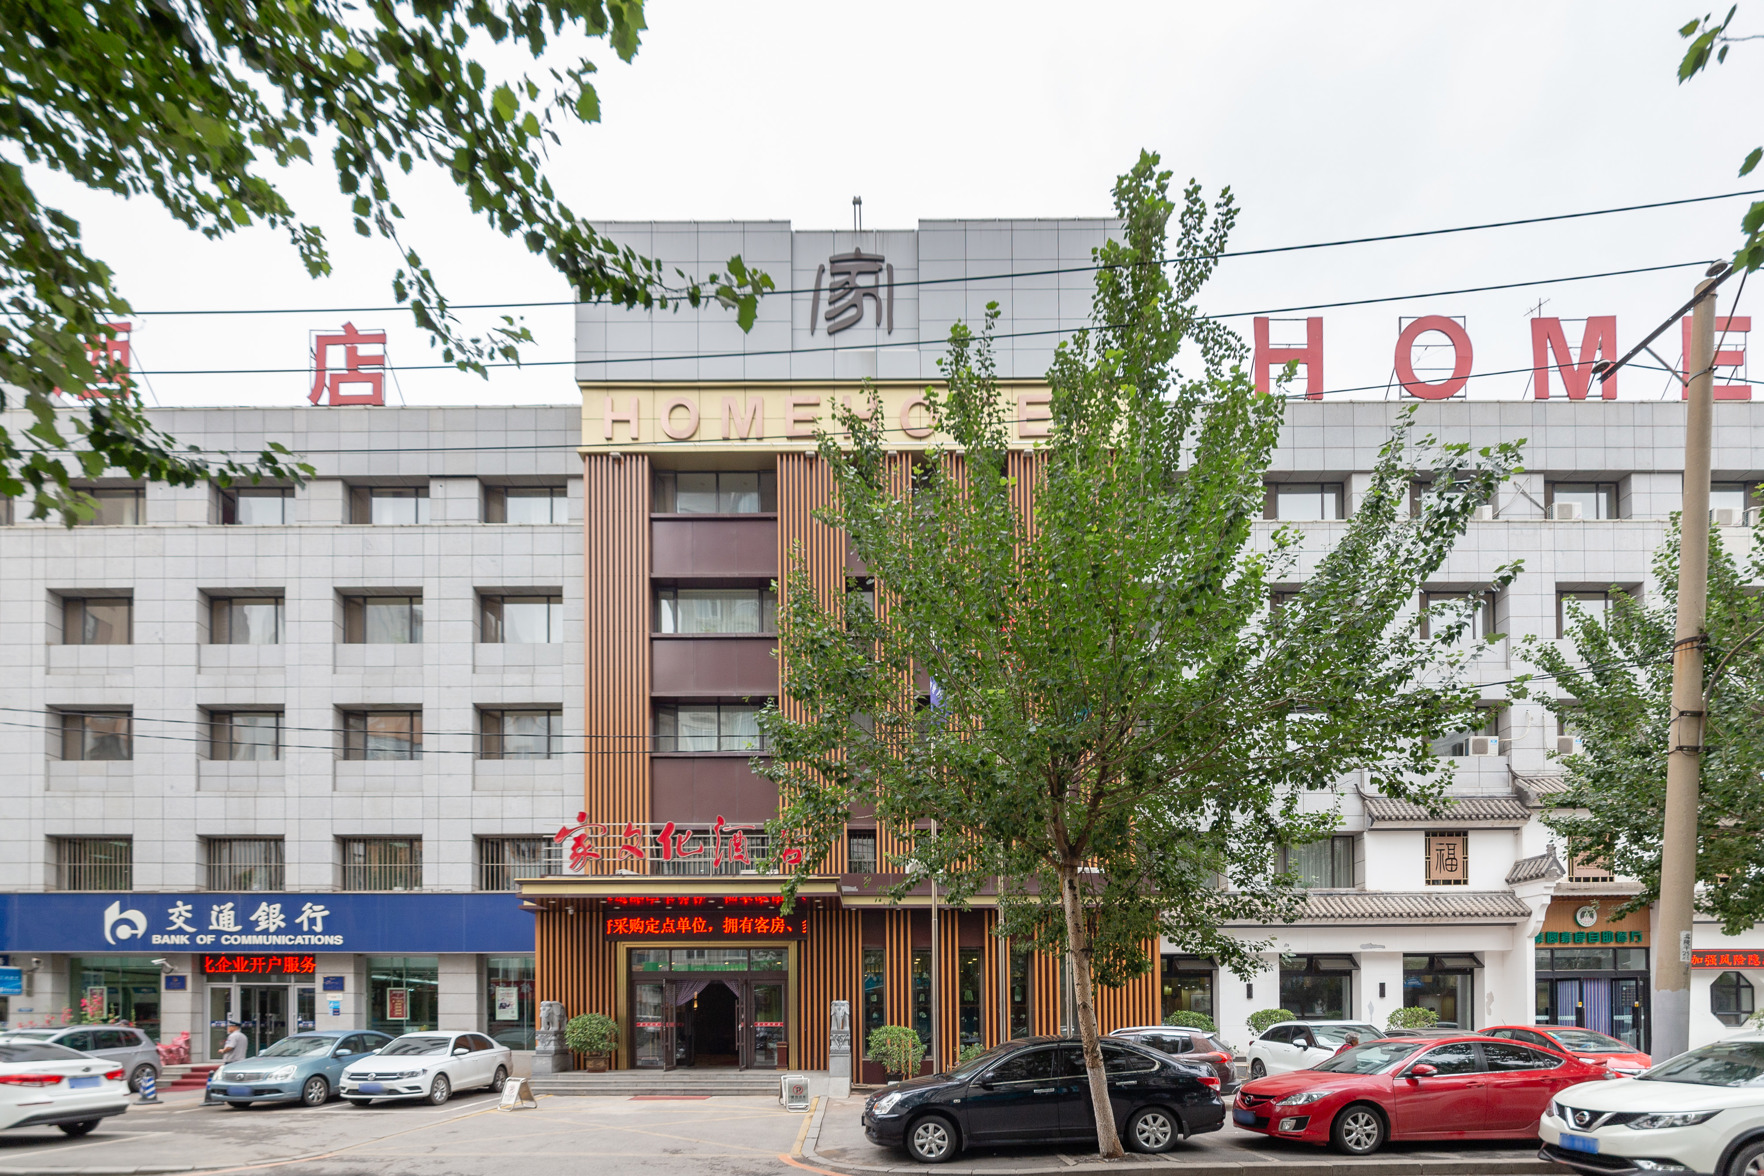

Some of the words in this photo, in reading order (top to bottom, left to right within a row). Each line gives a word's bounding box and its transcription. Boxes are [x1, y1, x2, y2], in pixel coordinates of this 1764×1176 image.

[1253, 314, 1752, 401] HOME
[602, 394, 1053, 440] HOMEHOE
[151, 934, 190, 945] BANK
[196, 934, 216, 945] OF
[220, 934, 344, 945] COMMUNICATIONS
[1691, 953, 1764, 967] 加强风险隐
